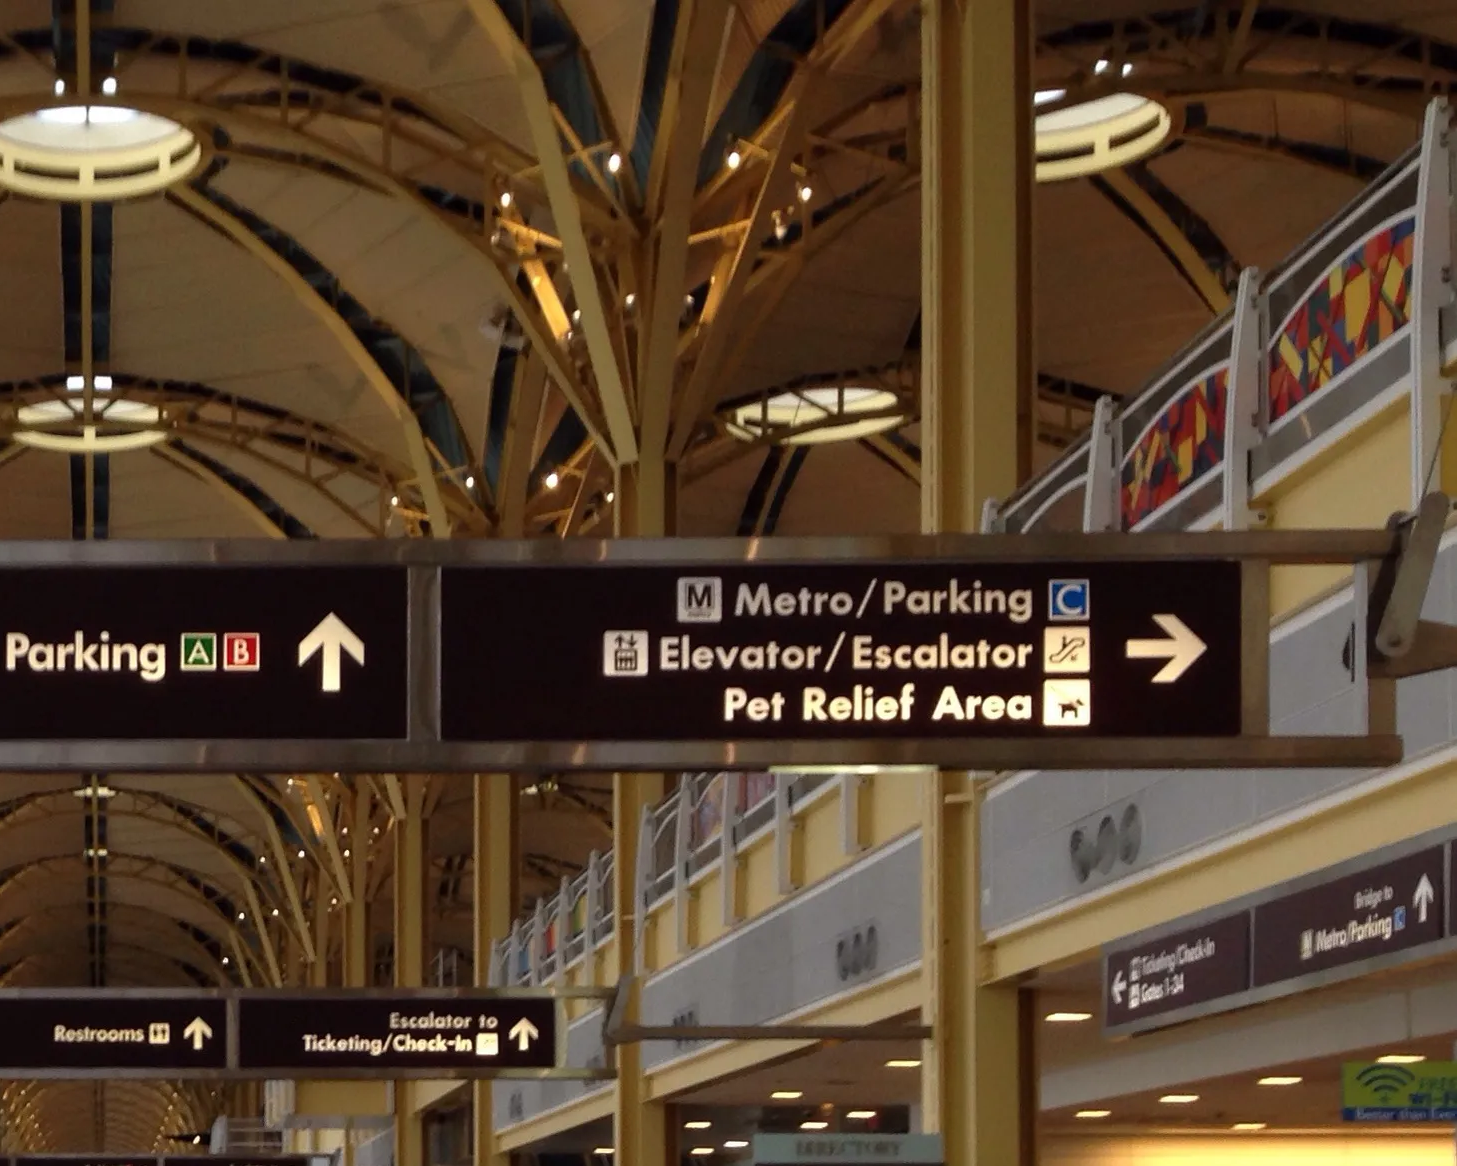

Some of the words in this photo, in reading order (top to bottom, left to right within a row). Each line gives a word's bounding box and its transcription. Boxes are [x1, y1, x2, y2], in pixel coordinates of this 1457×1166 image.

[734, 578, 1033, 623] Metro/Parking
[1055, 584, 1084, 615] C
[5, 629, 167, 682] Parking
[660, 631, 1033, 673] Elevator/Escalator
[724, 686, 785, 722] Pet
[803, 683, 915, 722] Relief
[932, 686, 1033, 722] Area
[54, 1024, 144, 1042] Restrooms
[389, 1011, 473, 1030] Escalator
[478, 1014, 499, 1030] to
